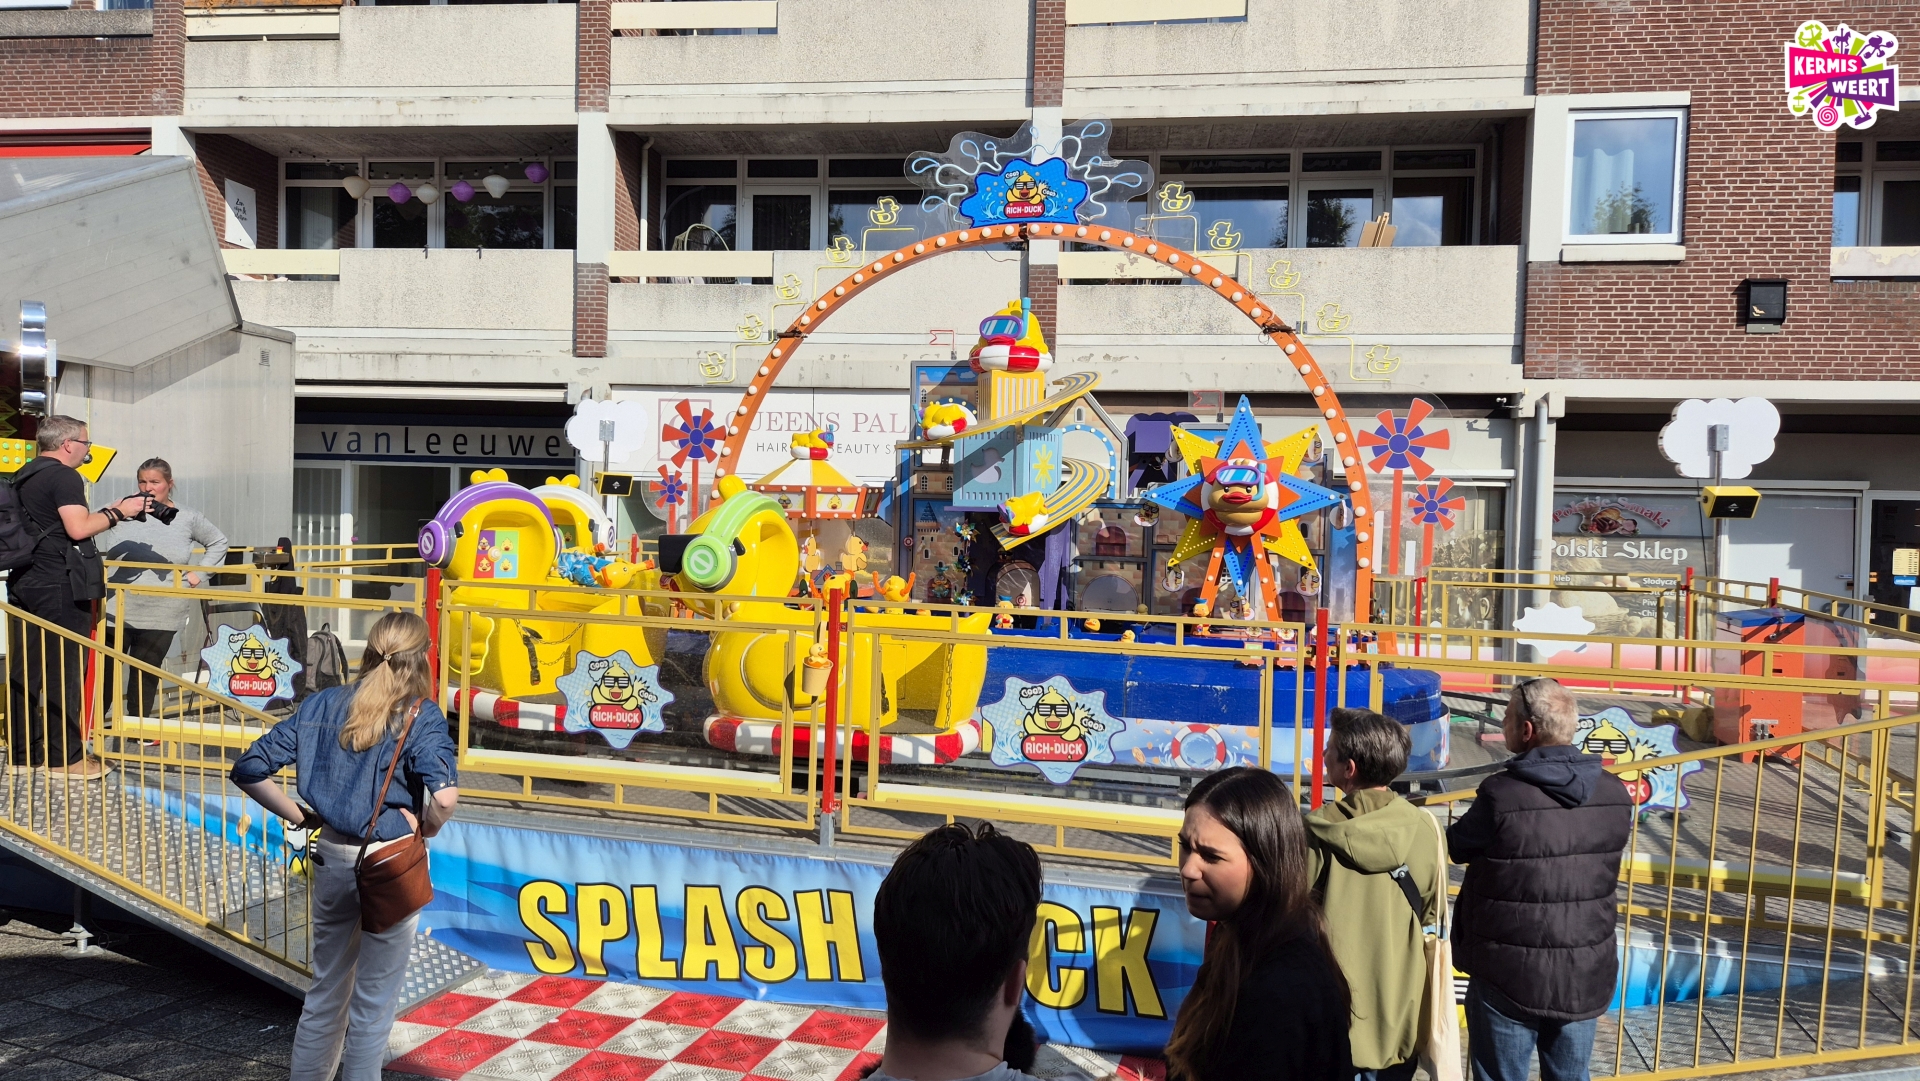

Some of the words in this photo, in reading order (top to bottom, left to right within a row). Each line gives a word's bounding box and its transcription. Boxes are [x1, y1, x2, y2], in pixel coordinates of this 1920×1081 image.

[852, 412, 908, 433] PAL
[321, 427, 576, 457] vanLeeuwe
[756, 442, 788, 453] HAIR
[832, 443, 880, 455] EAUTY
[1617, 497, 1671, 529] Smaki
[1613, 540, 1688, 566] Sklep
[1553, 574, 1571, 582] hleb
[1642, 598, 1657, 607] Piw
[1020, 686, 1043, 698] GOOD
[518, 879, 867, 984] SPLASH
[1026, 901, 1168, 1020] CK
